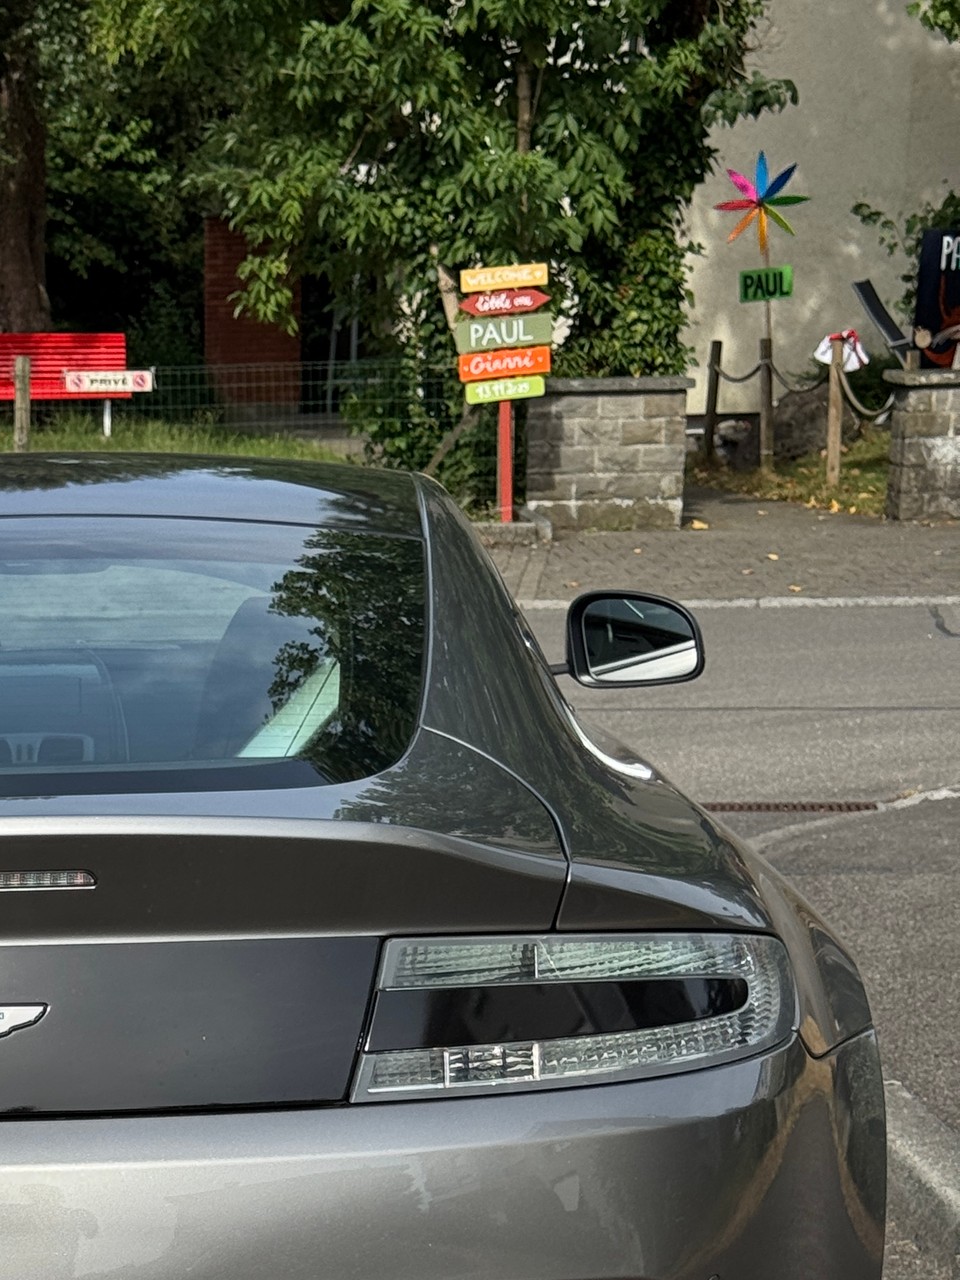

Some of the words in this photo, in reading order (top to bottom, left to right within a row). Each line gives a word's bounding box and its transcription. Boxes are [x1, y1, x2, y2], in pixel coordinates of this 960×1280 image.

[466, 267, 533, 287] WELCOME
[743, 271, 790, 299] PAUL
[470, 319, 534, 347] PAUL
[469, 350, 534, 375] Gianni
